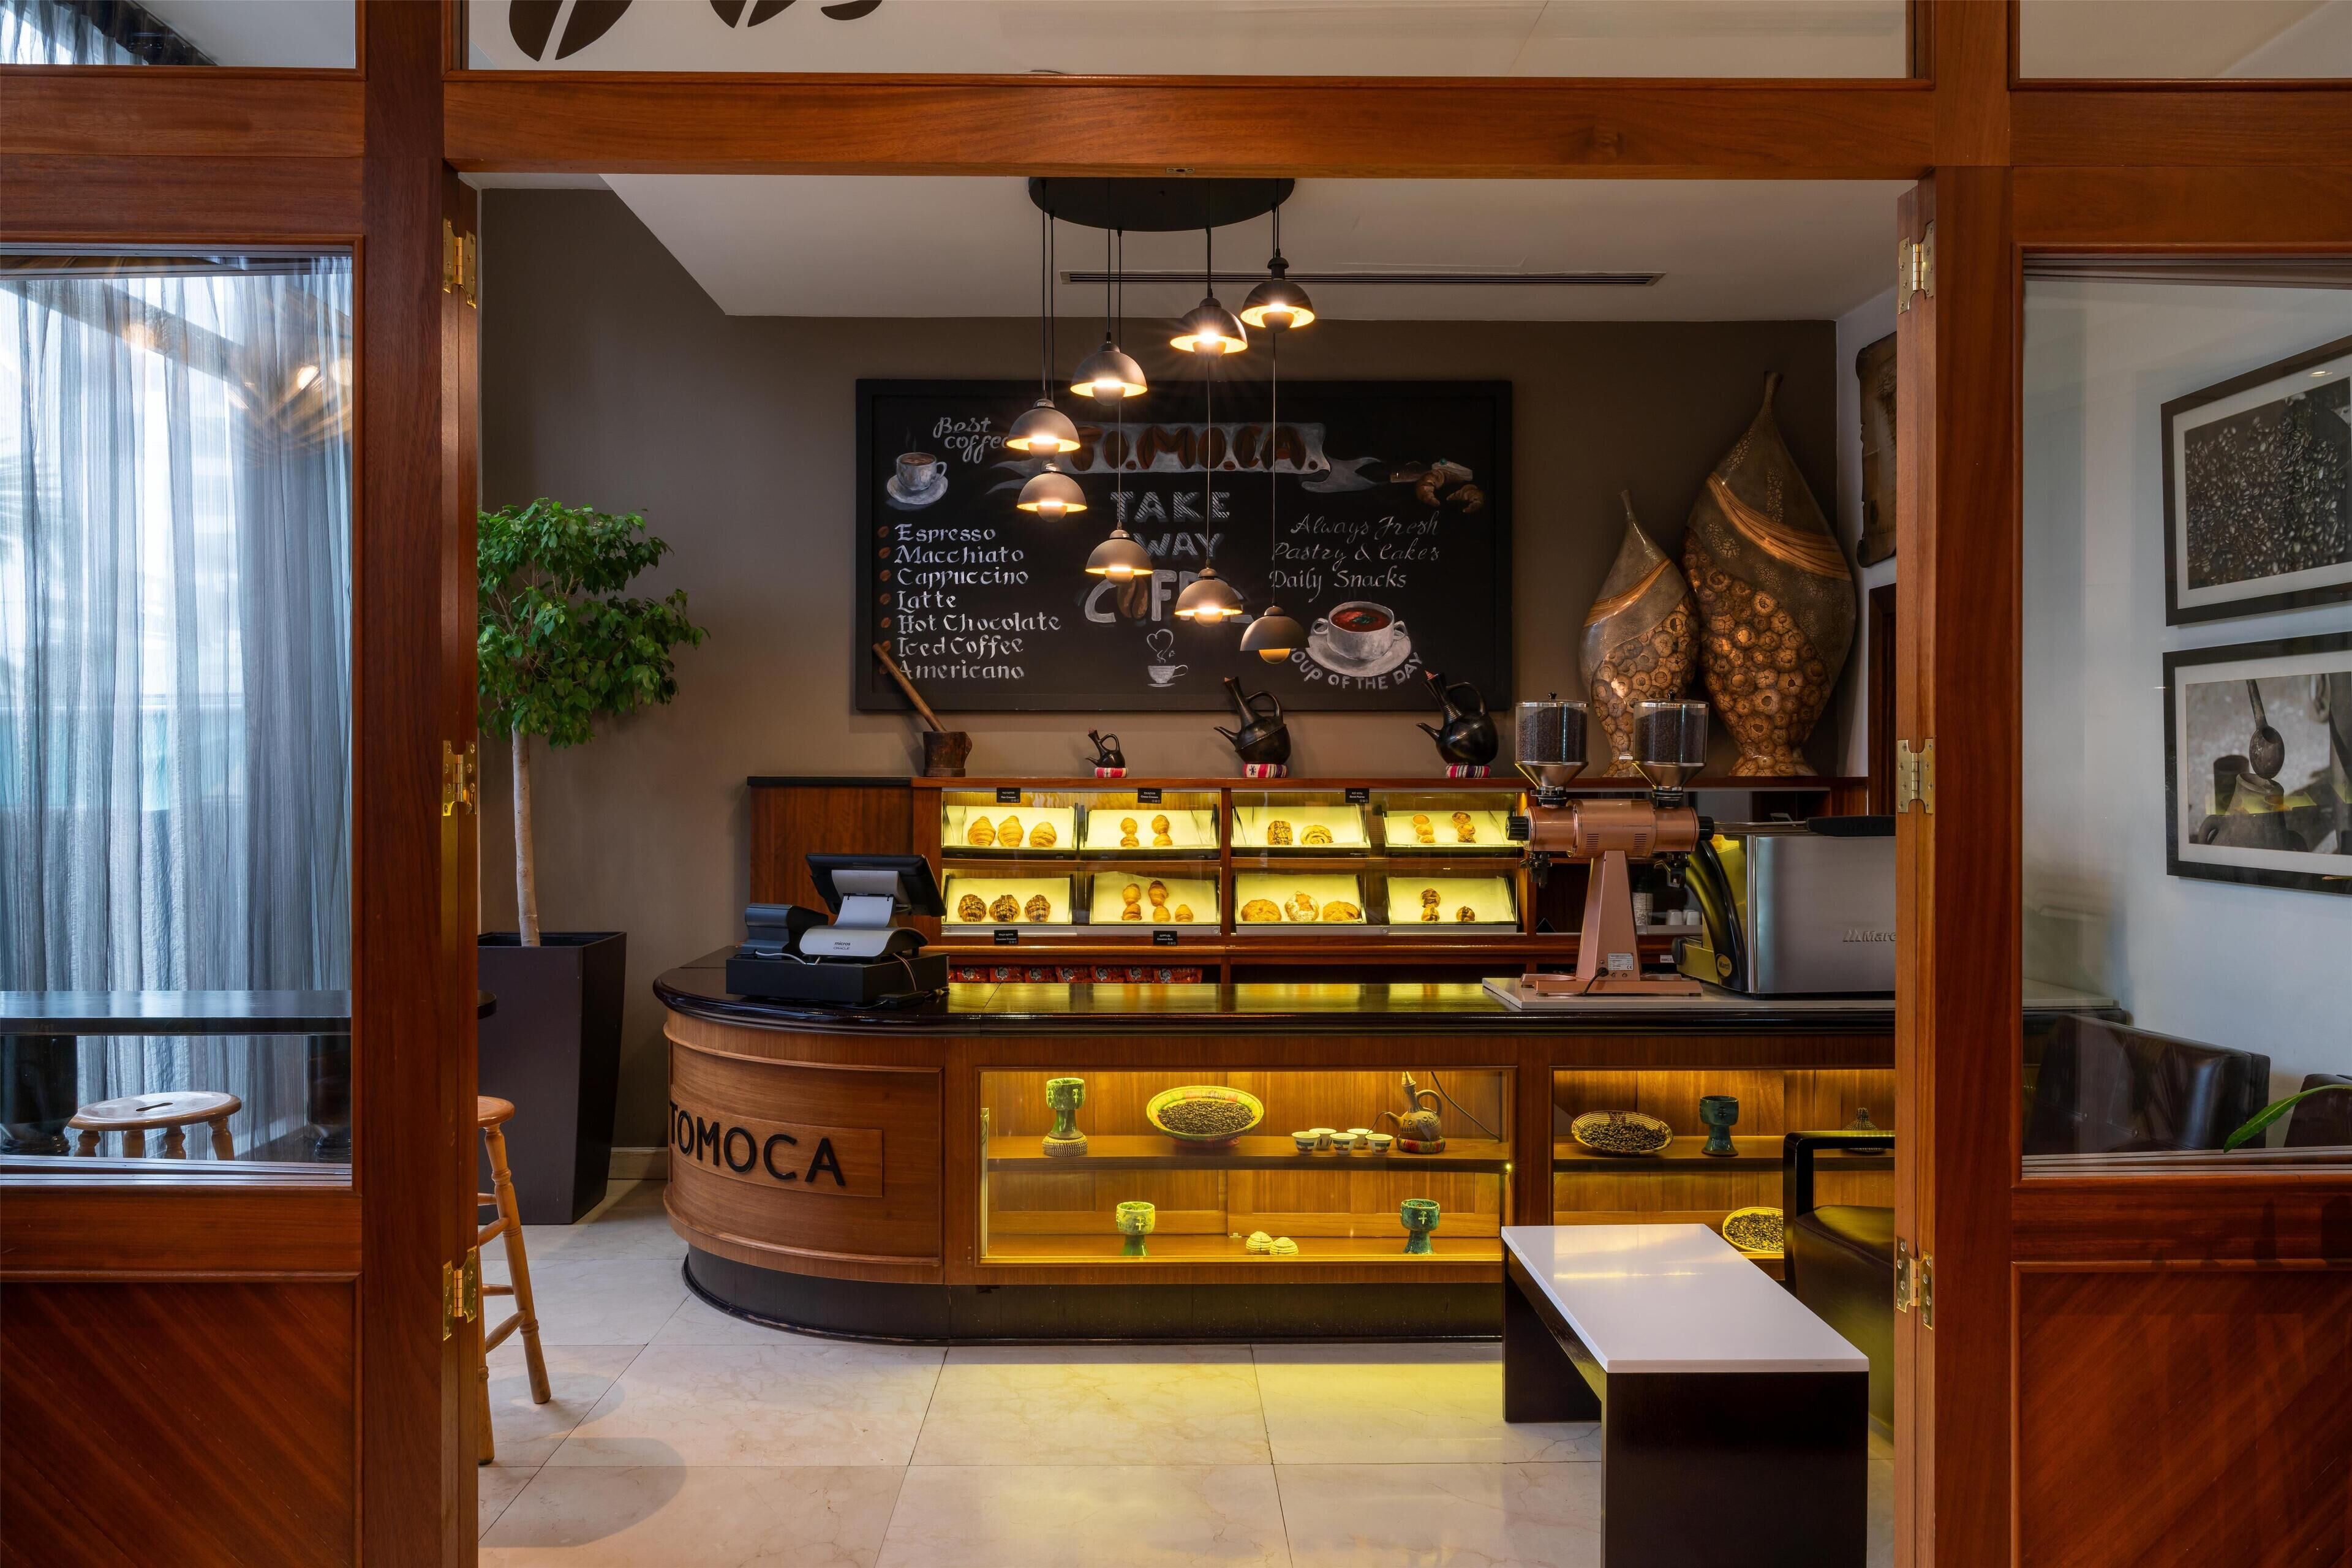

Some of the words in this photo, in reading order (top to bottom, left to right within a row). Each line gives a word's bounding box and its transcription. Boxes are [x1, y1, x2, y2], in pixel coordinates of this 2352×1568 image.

[932, 417, 991, 438] Best
[1110, 491, 1231, 521] TAKE
[894, 523, 996, 543] Espresso
[1291, 513, 1370, 544] Always
[1374, 510, 1439, 540] Fresh
[894, 545, 1024, 564] Macchiato
[1272, 542, 1347, 572] Pastry
[1354, 543, 1372, 562] &
[1379, 538, 1439, 562] Cakes
[897, 567, 1029, 589] Cappuccino
[1269, 567, 1322, 603] Daily
[1333, 565, 1407, 589] Snacks
[896, 590, 957, 612] Latte
[896, 613, 937, 634] Hot
[943, 612, 1061, 633] Chocolate
[897, 636, 946, 657] Iced
[950, 635, 1023, 659] Coffee
[900, 660, 1025, 680] Americano
[1291, 648, 1324, 682] OUP
[1327, 674, 1351, 690] OF
[1355, 677, 1389, 690] THE
[1393, 652, 1423, 685] DAY
[669, 1099, 845, 1187] TOMOCA
